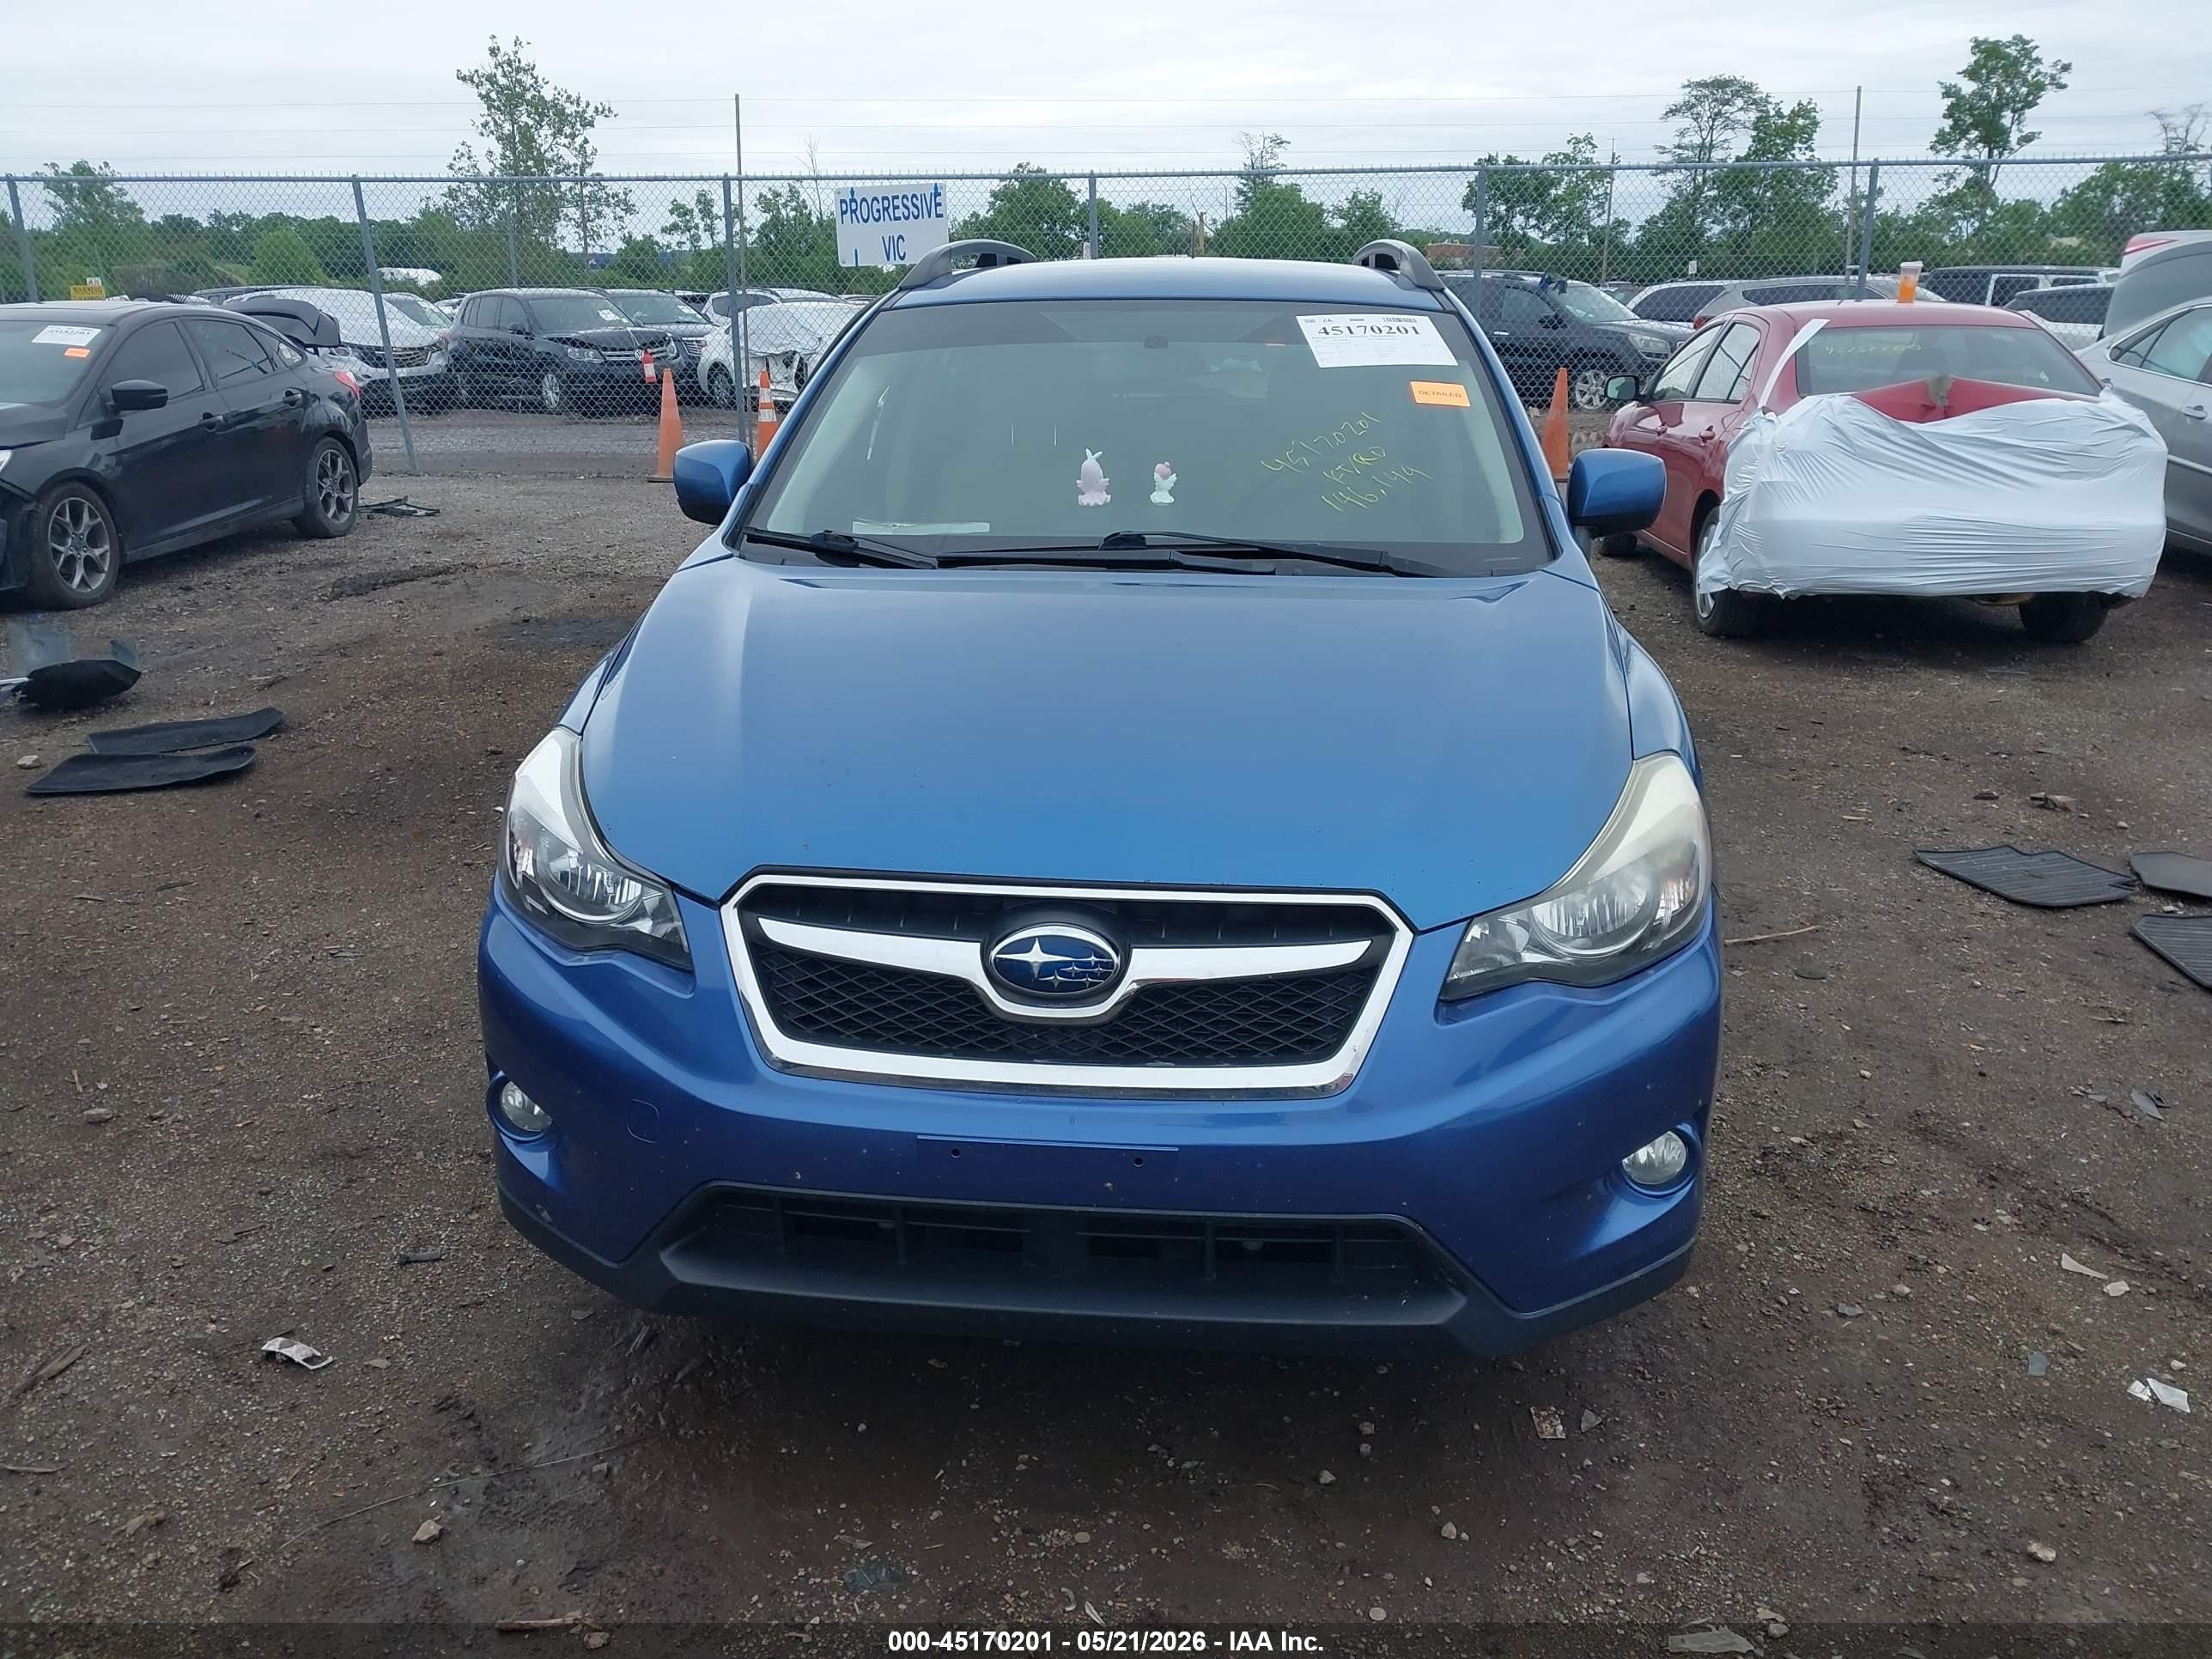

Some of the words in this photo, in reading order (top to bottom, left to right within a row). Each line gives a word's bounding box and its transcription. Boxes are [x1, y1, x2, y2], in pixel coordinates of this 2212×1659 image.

[840, 191, 944, 224] PROGRESSIVE
[882, 234, 907, 262] VIC
[1317, 325, 1421, 336] 45170201
[1260, 411, 1382, 474] 45170201
